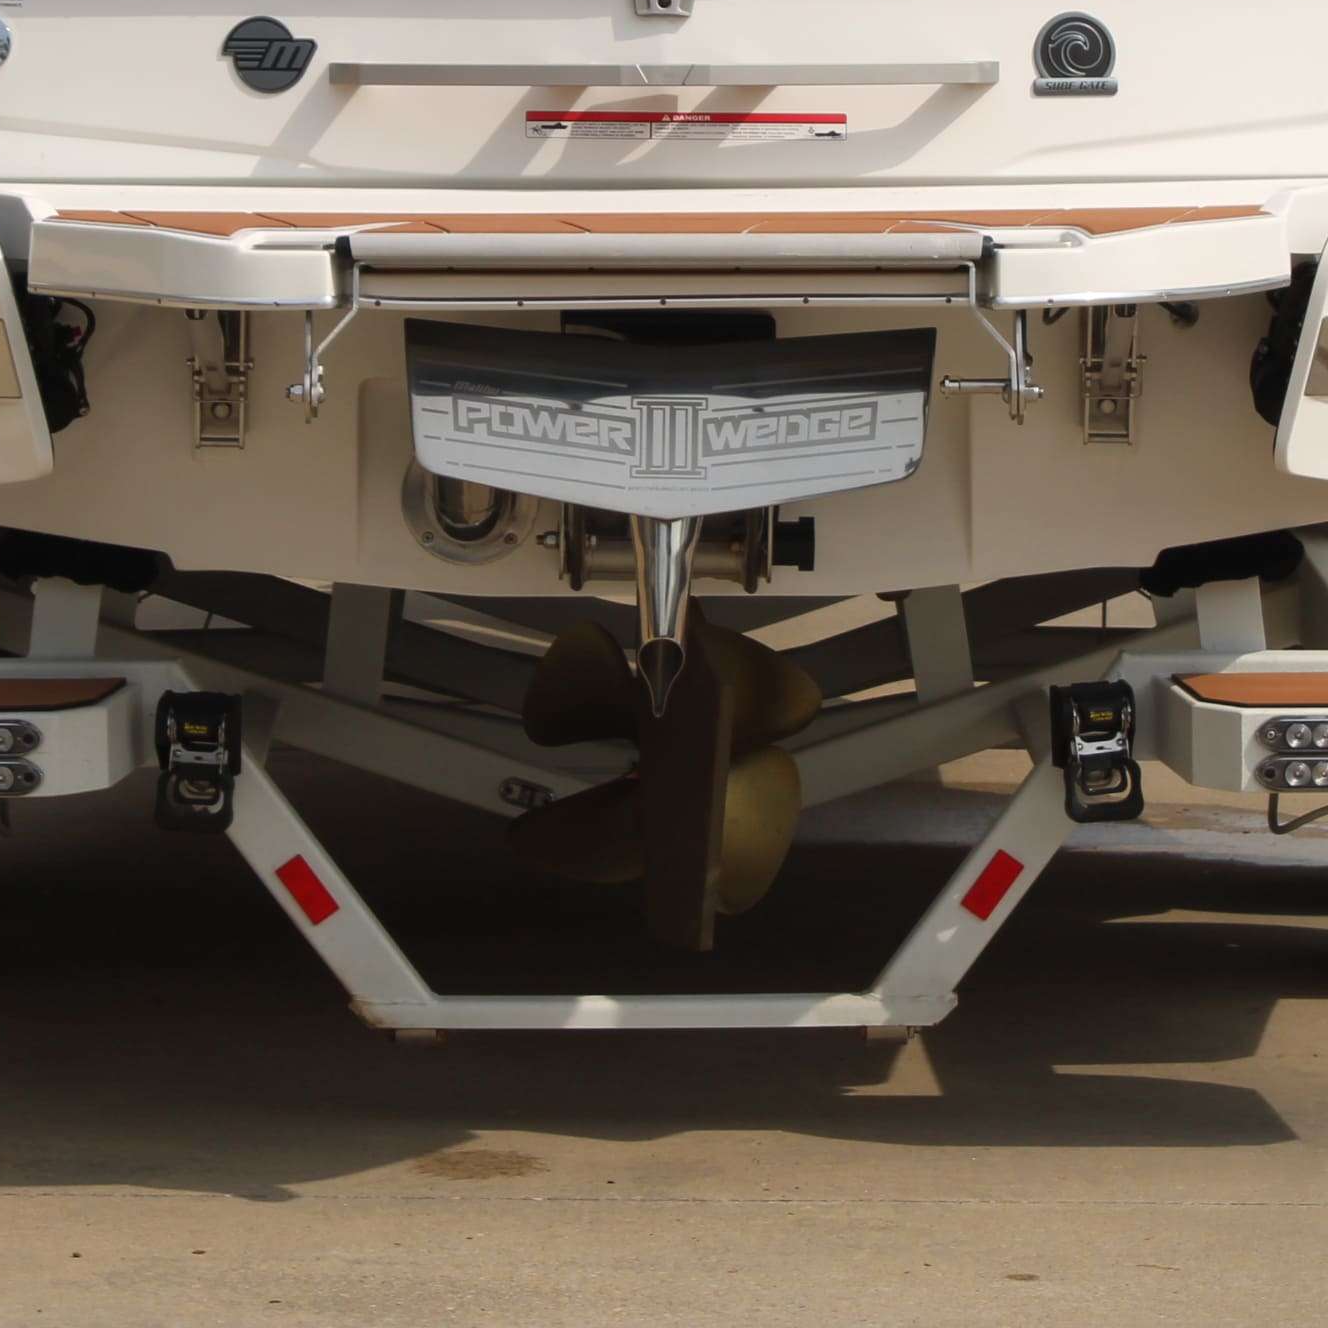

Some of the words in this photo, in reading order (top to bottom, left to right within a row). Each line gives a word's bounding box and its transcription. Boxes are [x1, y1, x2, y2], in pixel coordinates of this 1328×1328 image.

[672, 114, 711, 122] DANGER
[457, 399, 633, 451] POWER
[706, 406, 873, 452] WEDGE
